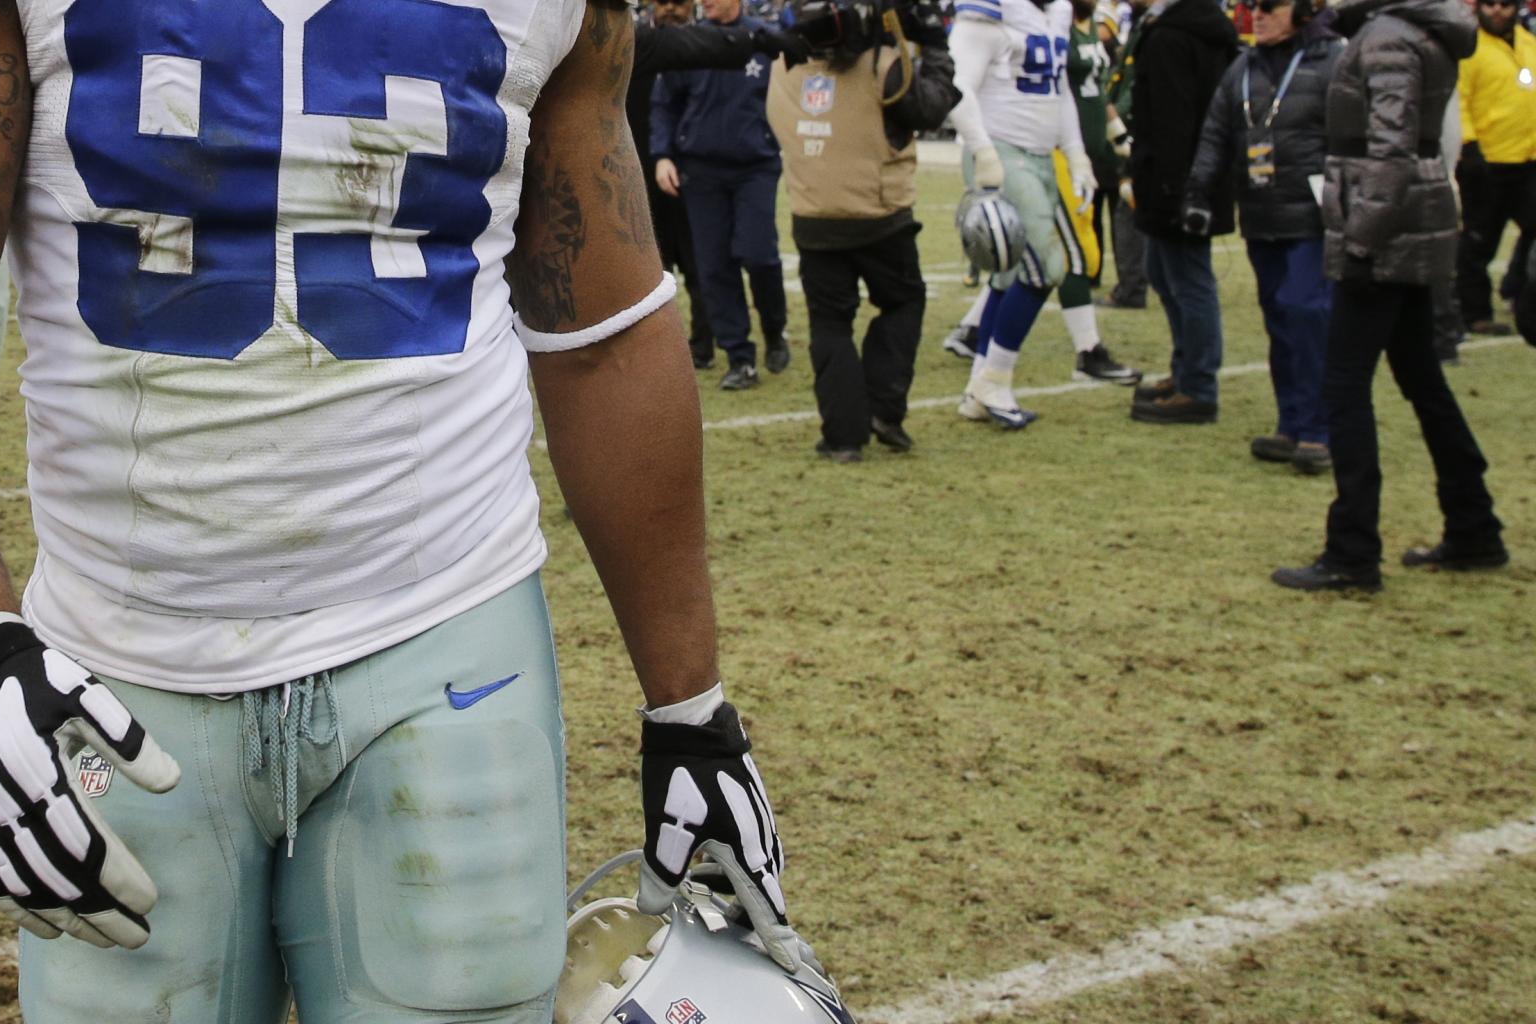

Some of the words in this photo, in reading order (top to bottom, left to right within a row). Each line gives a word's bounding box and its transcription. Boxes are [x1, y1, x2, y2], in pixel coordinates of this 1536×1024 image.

[797, 121, 831, 135] MEDIA
[80, 771, 104, 794] NFL
[668, 1001, 696, 1024] NFL
